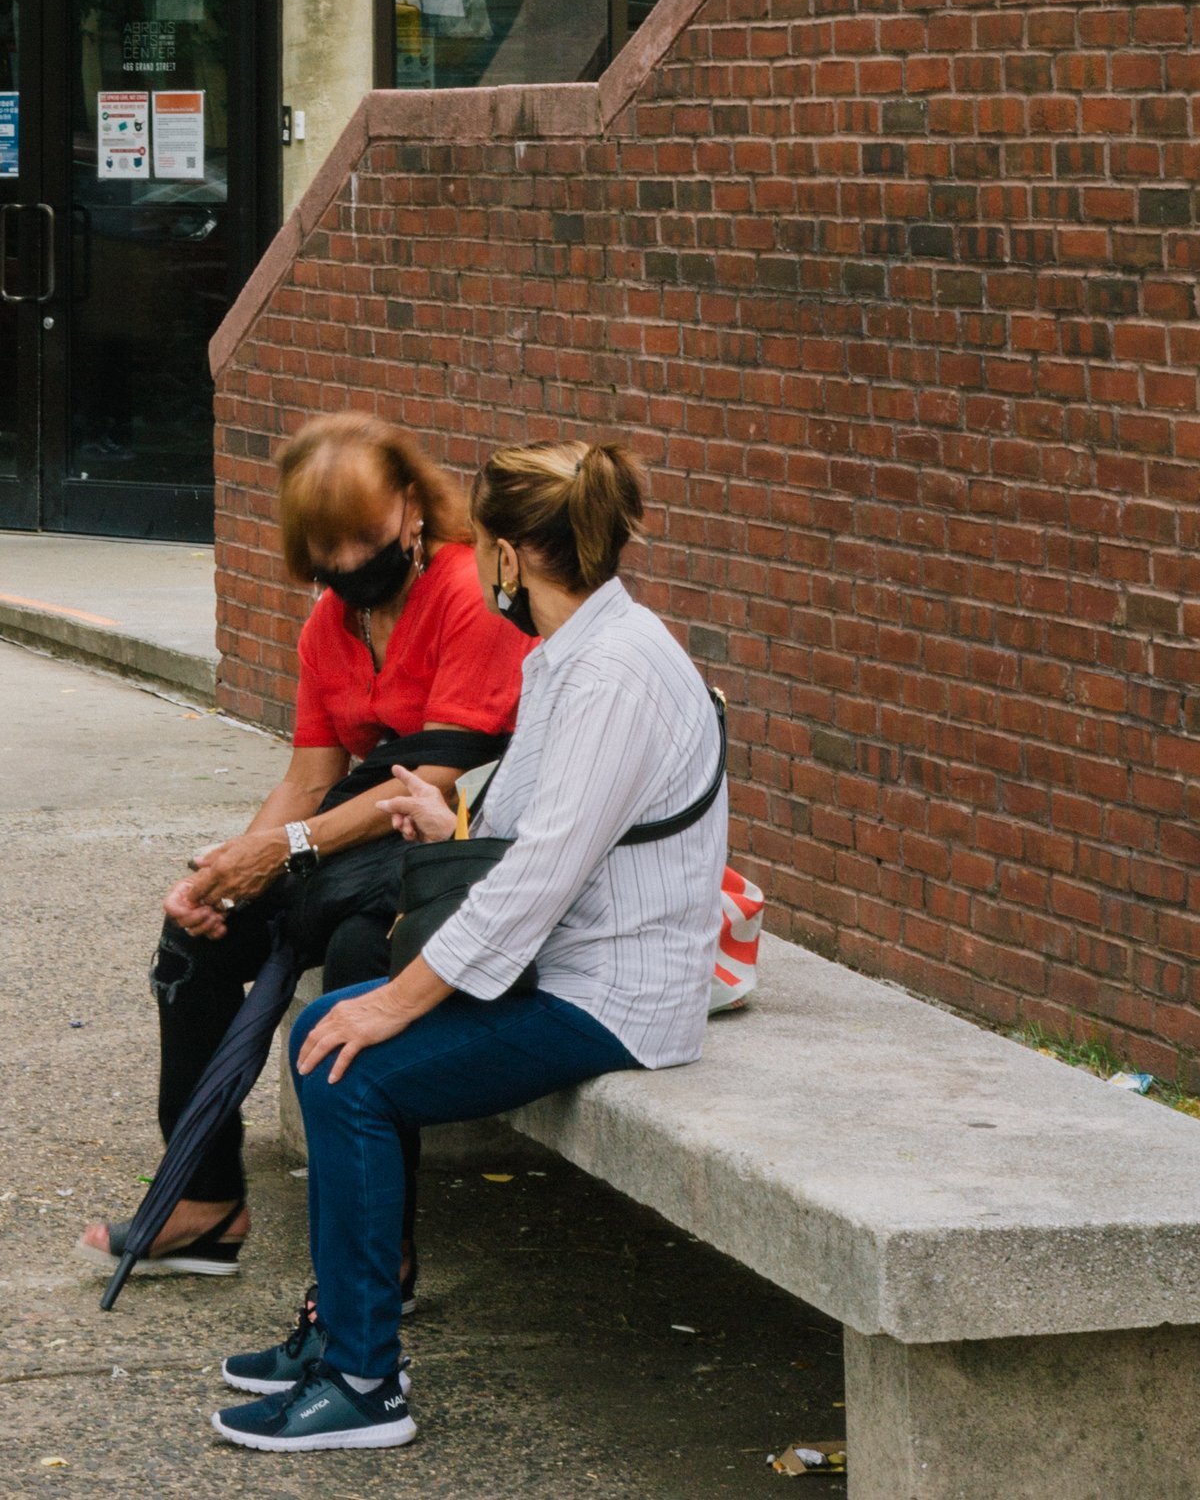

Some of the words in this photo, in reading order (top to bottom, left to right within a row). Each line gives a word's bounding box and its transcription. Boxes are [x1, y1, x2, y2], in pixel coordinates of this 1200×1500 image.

[122, 21, 176, 34] ABRONS
[123, 34, 158, 47] ARTS
[122, 47, 176, 59] CENTER
[122, 62, 134, 71] 466
[135, 62, 154, 71] GRAND
[155, 62, 176, 71] STREET
[300, 1398, 330, 1420] NAUTICA
